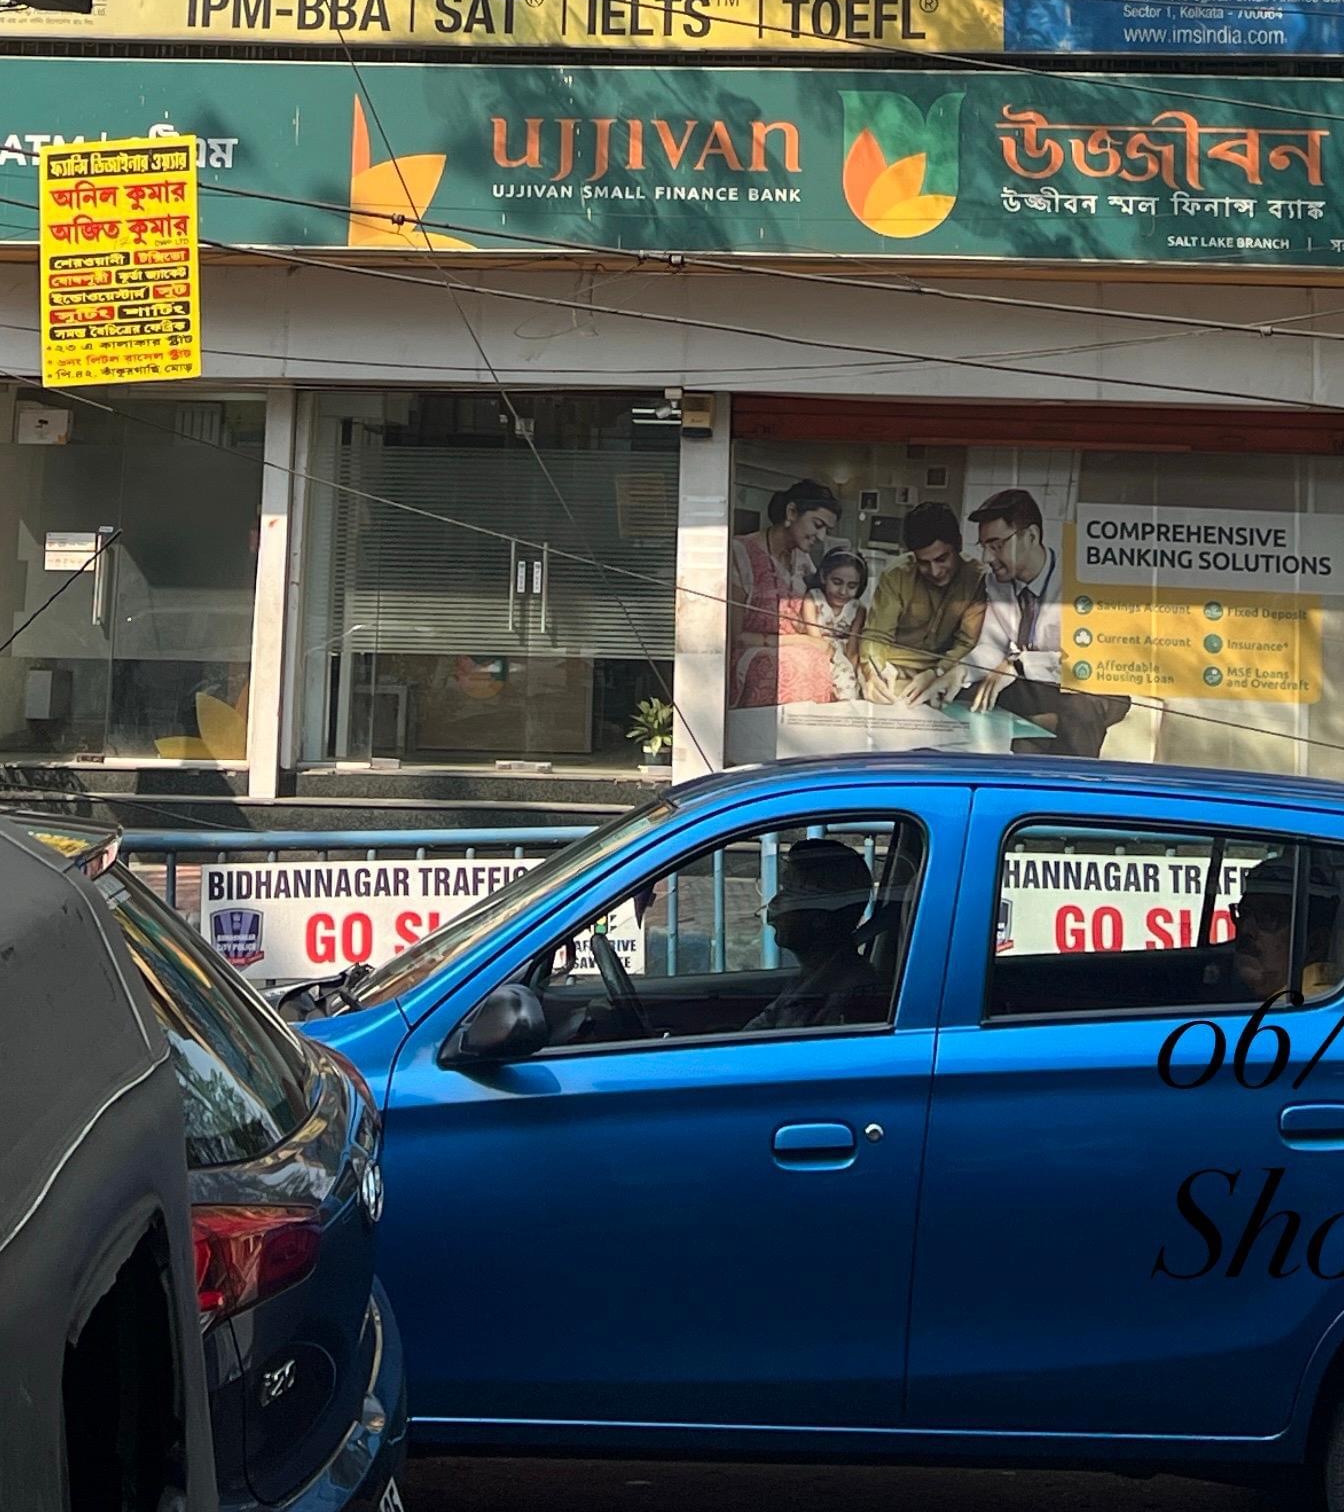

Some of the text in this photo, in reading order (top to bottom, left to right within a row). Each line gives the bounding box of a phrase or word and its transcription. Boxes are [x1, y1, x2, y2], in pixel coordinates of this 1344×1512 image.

[1124, 6, 1162, 19] Sector
[1180, 6, 1224, 19] Kolkata
[1124, 26, 1286, 45] www.imsindia.com
[995, 104, 1330, 190] উজ্জীবন
[49, 180, 187, 211] অনিল কুমার
[492, 184, 802, 203] UJJIVAN SMALL FINANCE BANK
[1001, 186, 1098, 214] উজ্জীবন
[1170, 191, 1258, 218] ফিনান্স
[48, 213, 190, 245] অজিত কুমার
[1167, 236, 1290, 250] SALT LAKE BRANCH
[1086, 520, 1287, 548] COMPREHENSIVE
[1086, 546, 1332, 576] BANKING SOLUTIONS
[1262, 608, 1308, 622] Deposit
[1097, 634, 1192, 648] Current Account
[1096, 661, 1160, 674] Affordable
[1096, 671, 1176, 685] Housing Loan
[1227, 667, 1290, 680] MSE Loans
[1227, 678, 1310, 691] and Overdraft
[208, 867, 410, 901] BIDHANNAGAR
[1005, 859, 1160, 893] HANNAGAR
[306, 911, 373, 964] GO
[1055, 905, 1123, 953] GO
